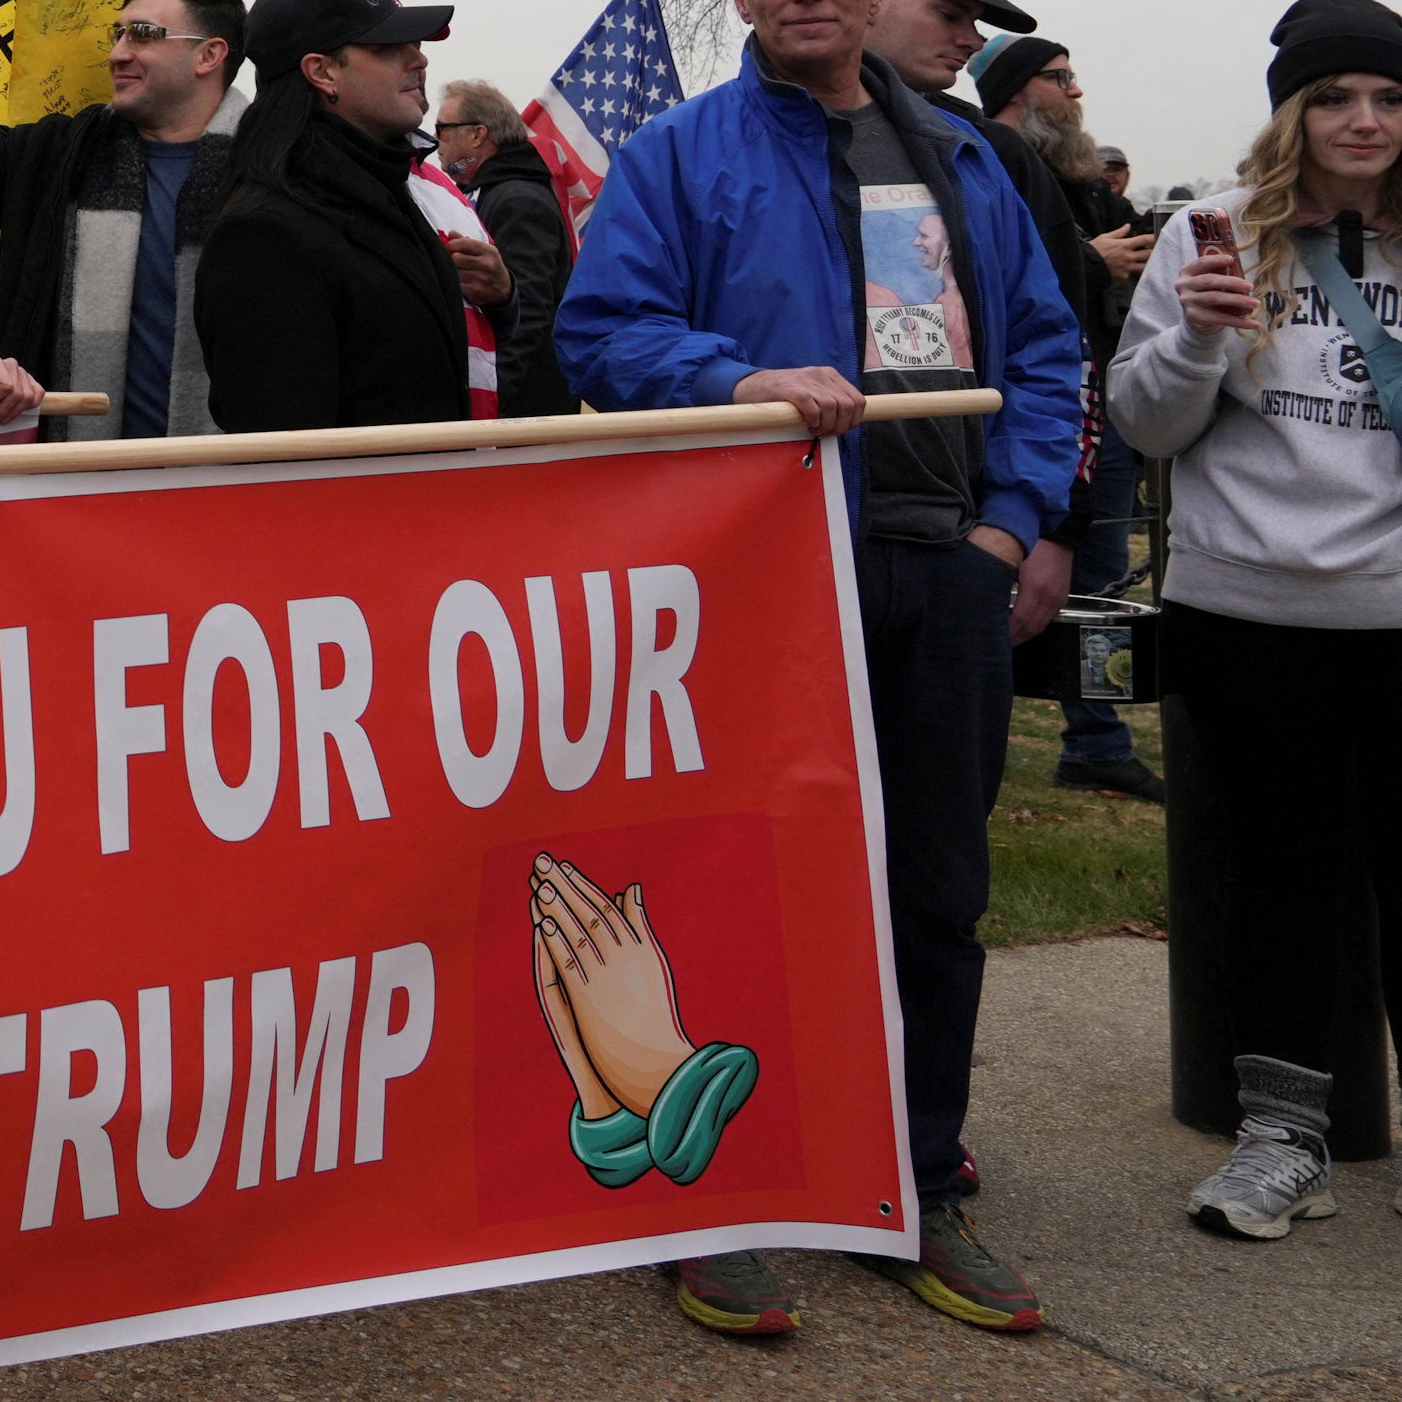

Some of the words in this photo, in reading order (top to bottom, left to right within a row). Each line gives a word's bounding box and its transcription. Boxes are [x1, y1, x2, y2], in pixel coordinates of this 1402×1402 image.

[905, 307, 932, 321] BECOMES
[883, 343, 923, 365] REBELLION
[924, 356, 931, 364] IS
[932, 342, 947, 360] DUTY
[891, 334, 901, 344] 17
[925, 332, 938, 343] 76
[1319, 348, 1343, 391] INSTITUTE
[1346, 388, 1359, 396] OF
[1261, 389, 1334, 425] INSTITUTE
[1338, 400, 1357, 428] OF
[92, 594, 391, 858] FOR
[427, 563, 706, 810] OUR
